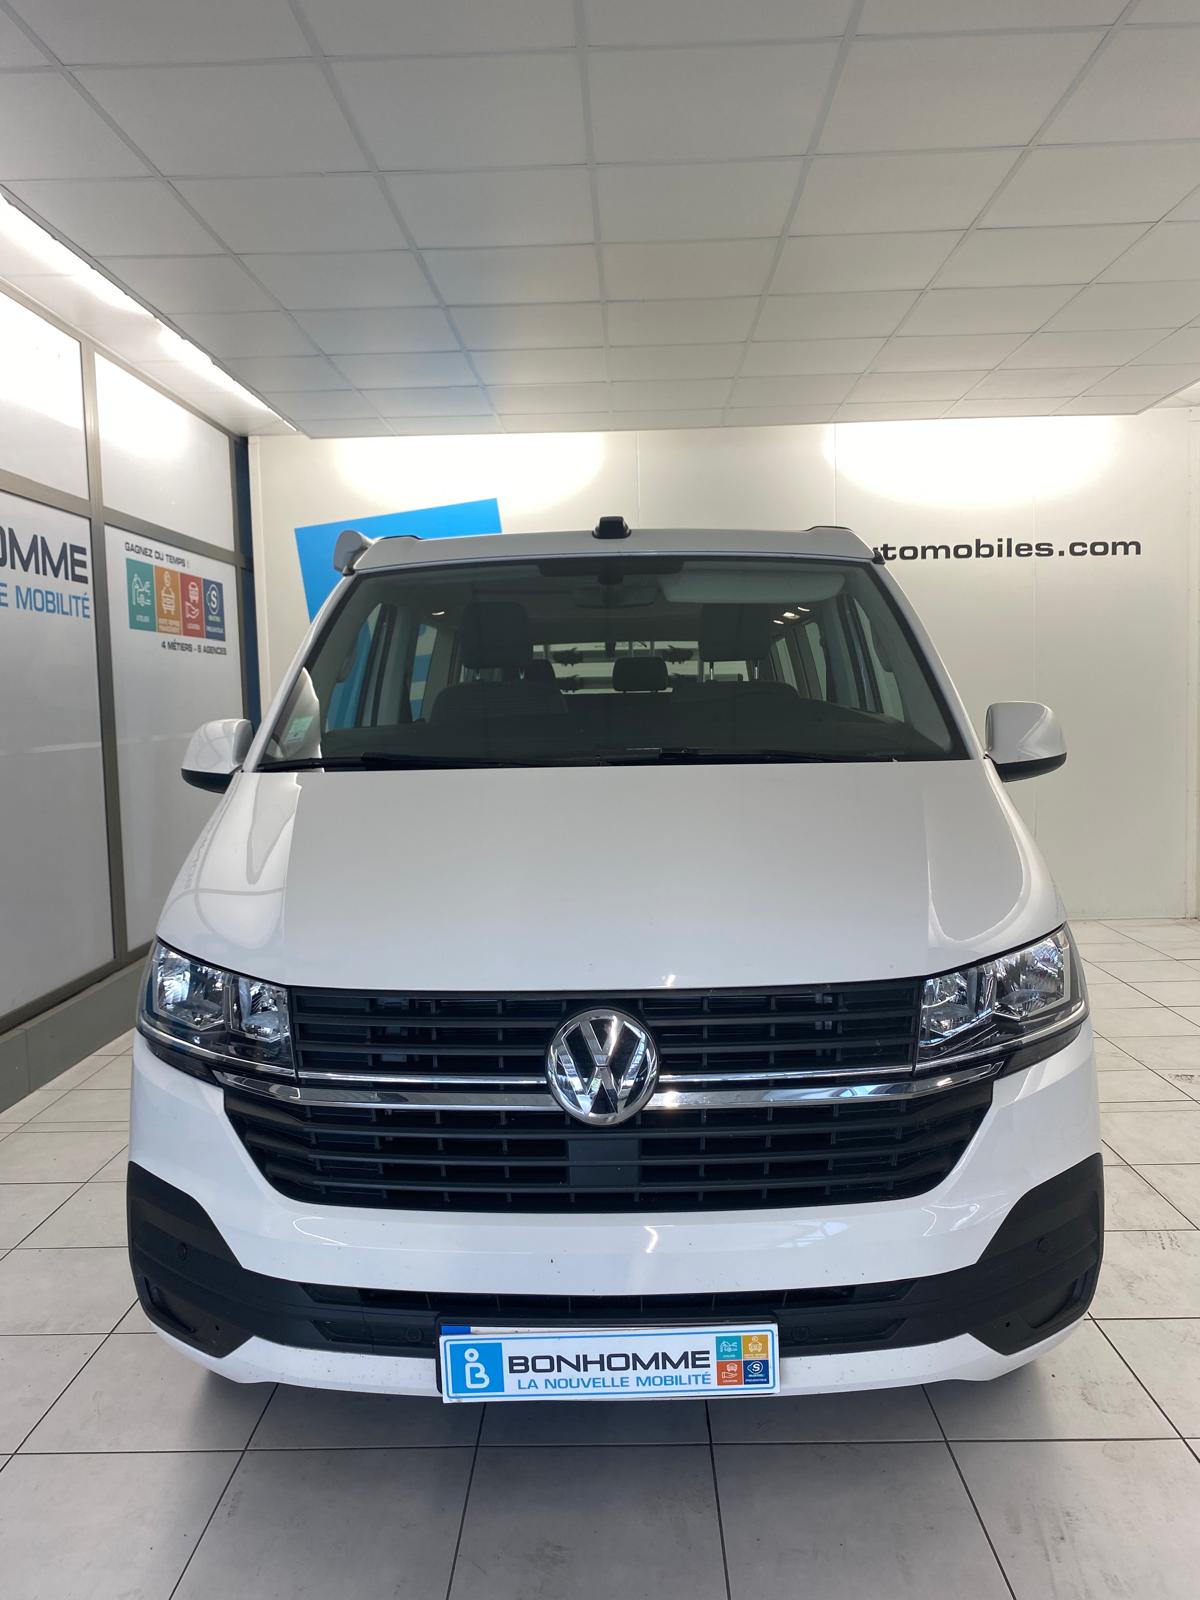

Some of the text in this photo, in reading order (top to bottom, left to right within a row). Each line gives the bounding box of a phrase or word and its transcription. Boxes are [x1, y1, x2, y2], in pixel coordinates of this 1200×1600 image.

[124, 541, 153, 559] GAGNEZ
[154, 550, 164, 561] DU
[165, 553, 186, 568] TEMPS
[15, 584, 91, 619] MOBILITÉ
[161, 641, 166, 649] 4
[167, 639, 193, 652] MÉTIERS
[508, 1350, 711, 1374] BONHOMME
[517, 1371, 712, 1390] LA NOUVELLE MOBILITÉ
